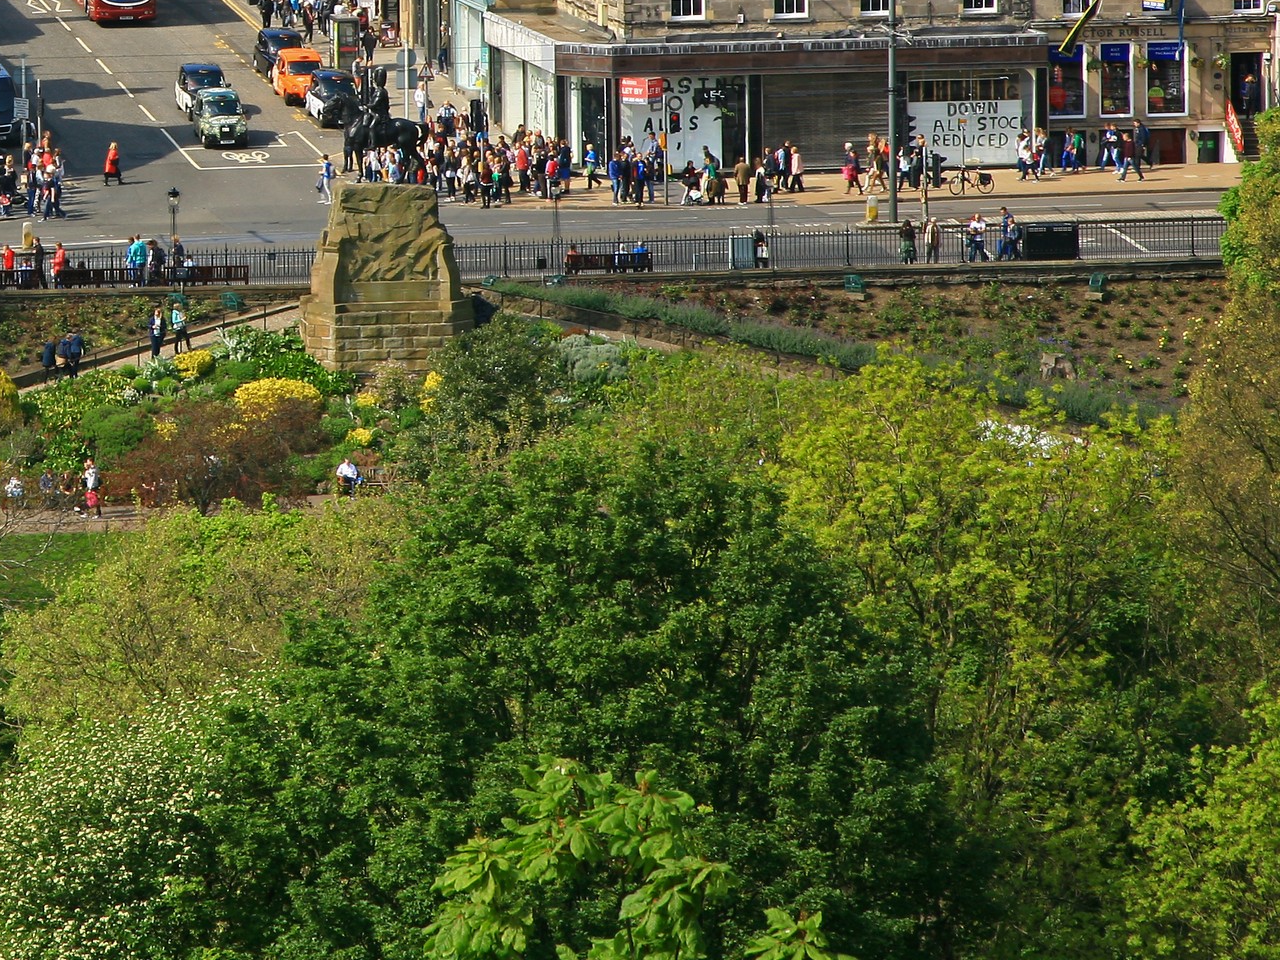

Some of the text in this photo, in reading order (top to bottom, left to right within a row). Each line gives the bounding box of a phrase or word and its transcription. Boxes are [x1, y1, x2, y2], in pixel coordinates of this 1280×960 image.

[1119, 27, 1166, 38] RUSSELL
[621, 87, 633, 95] LET
[947, 102, 998, 117] DOWN
[933, 116, 1027, 133] ALL STOCK
[932, 133, 1009, 148] REDUCED
